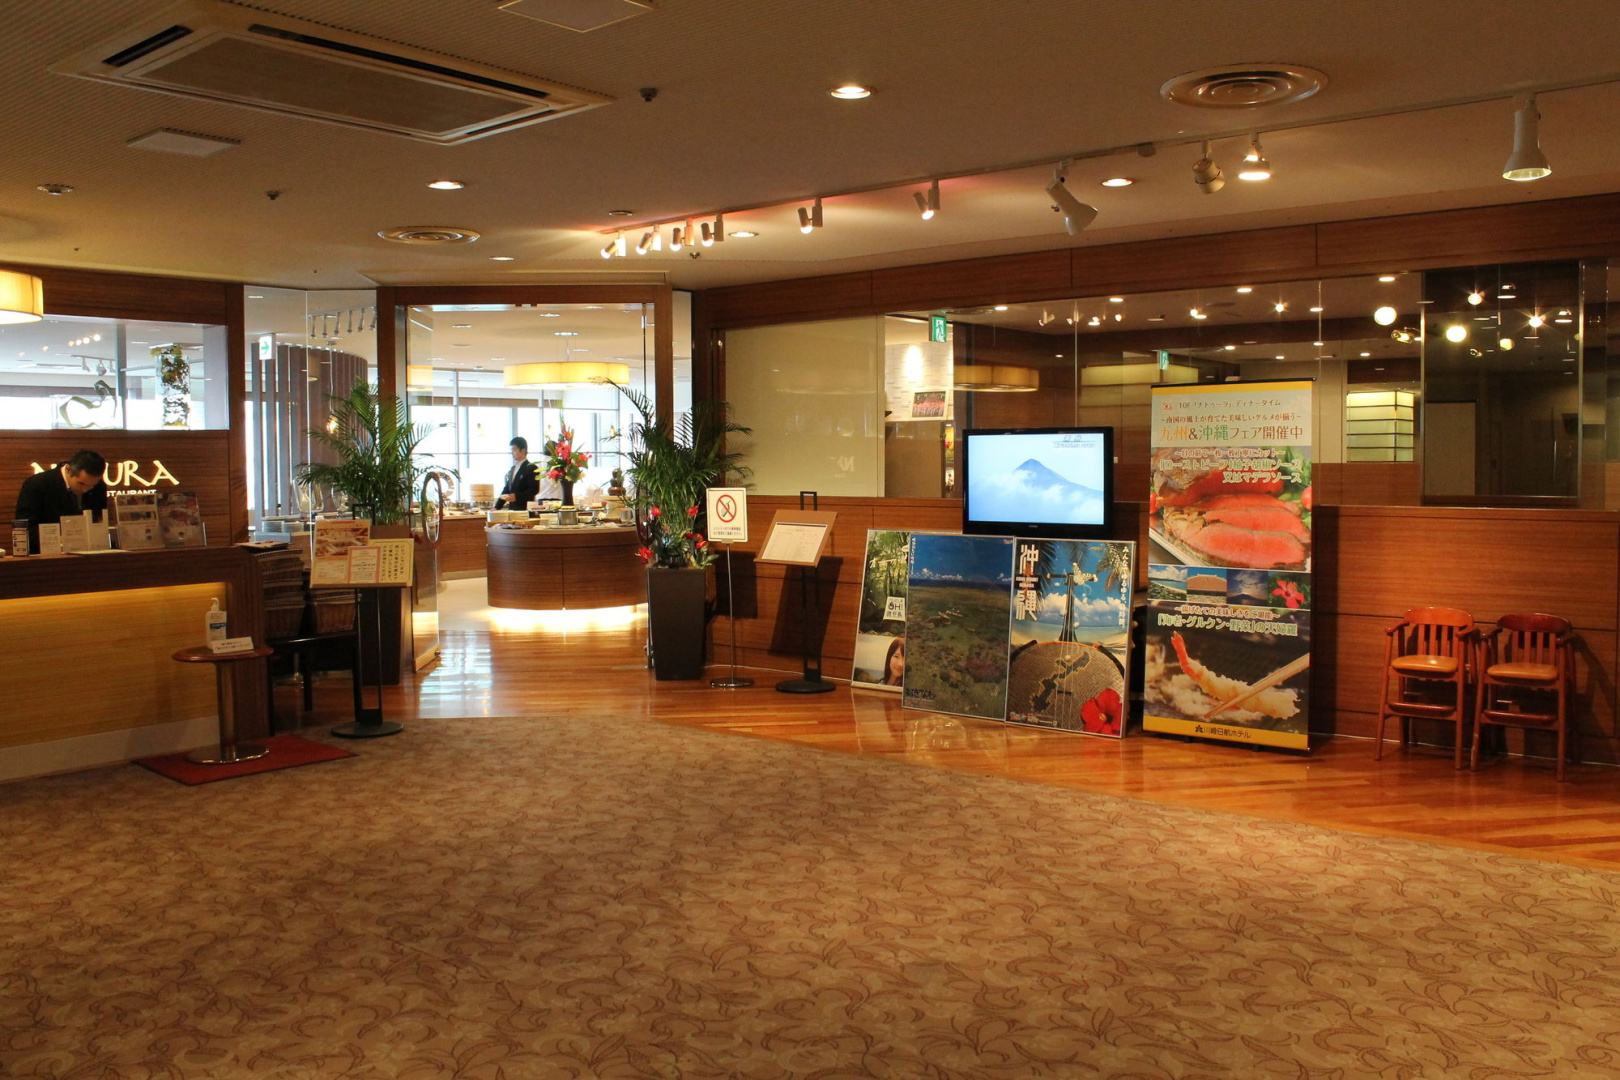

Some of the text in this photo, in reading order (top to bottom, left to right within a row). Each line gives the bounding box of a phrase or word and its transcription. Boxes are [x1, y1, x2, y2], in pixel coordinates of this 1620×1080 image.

[1222, 471, 1302, 483] 又はマデラソース
